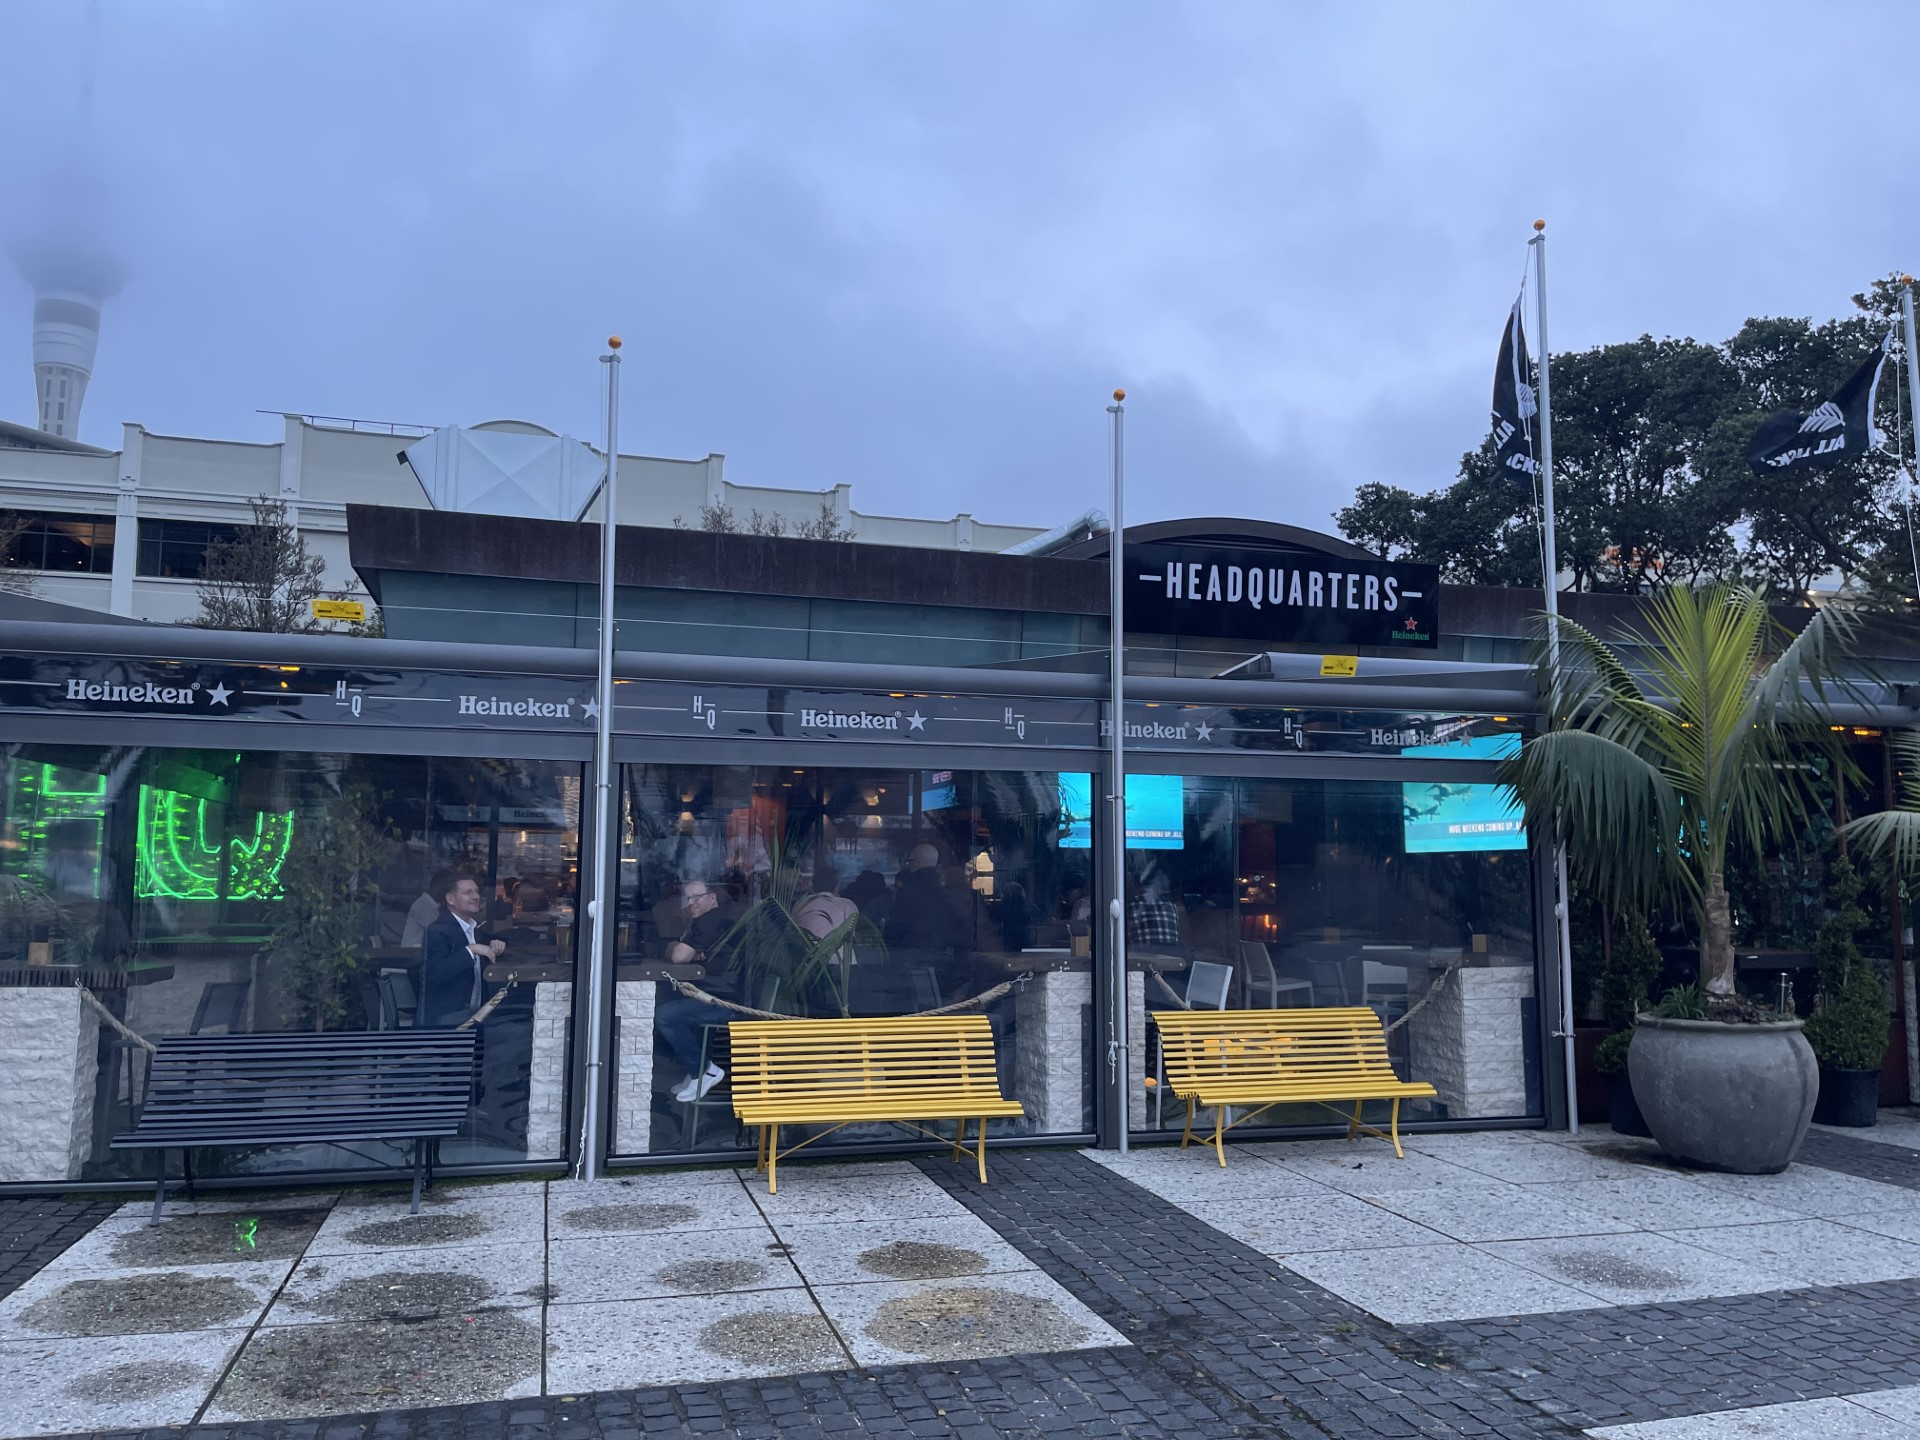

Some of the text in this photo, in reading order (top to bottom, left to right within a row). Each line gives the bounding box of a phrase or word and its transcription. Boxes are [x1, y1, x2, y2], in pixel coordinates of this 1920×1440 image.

[1166, 562, 1398, 611] HEADQUARTERS
[1392, 630, 1430, 641] Heineken
[1100, 720, 1190, 740] Hineken®
[1462, 823, 1484, 833] WEEKEND
[1485, 822, 1504, 832] COMING
